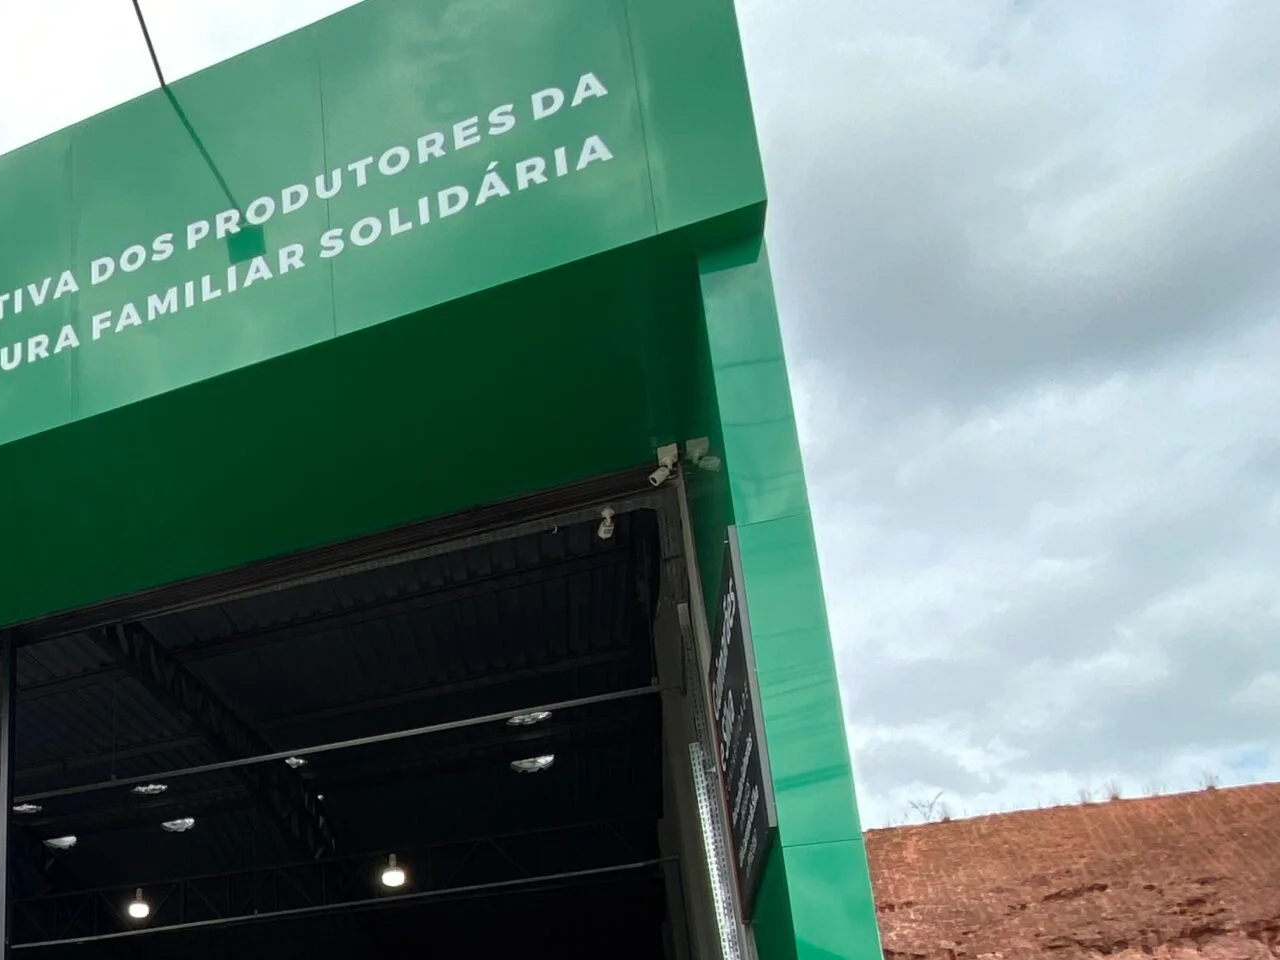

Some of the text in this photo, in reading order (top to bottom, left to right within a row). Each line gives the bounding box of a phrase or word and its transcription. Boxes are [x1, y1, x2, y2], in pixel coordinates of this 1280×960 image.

[90, 232, 174, 286] DOS
[186, 104, 516, 251] PRODUTORES
[530, 72, 609, 121] DA
[91, 243, 306, 340] FAMILIAR
[319, 135, 614, 259] SOLIDÁRIA
